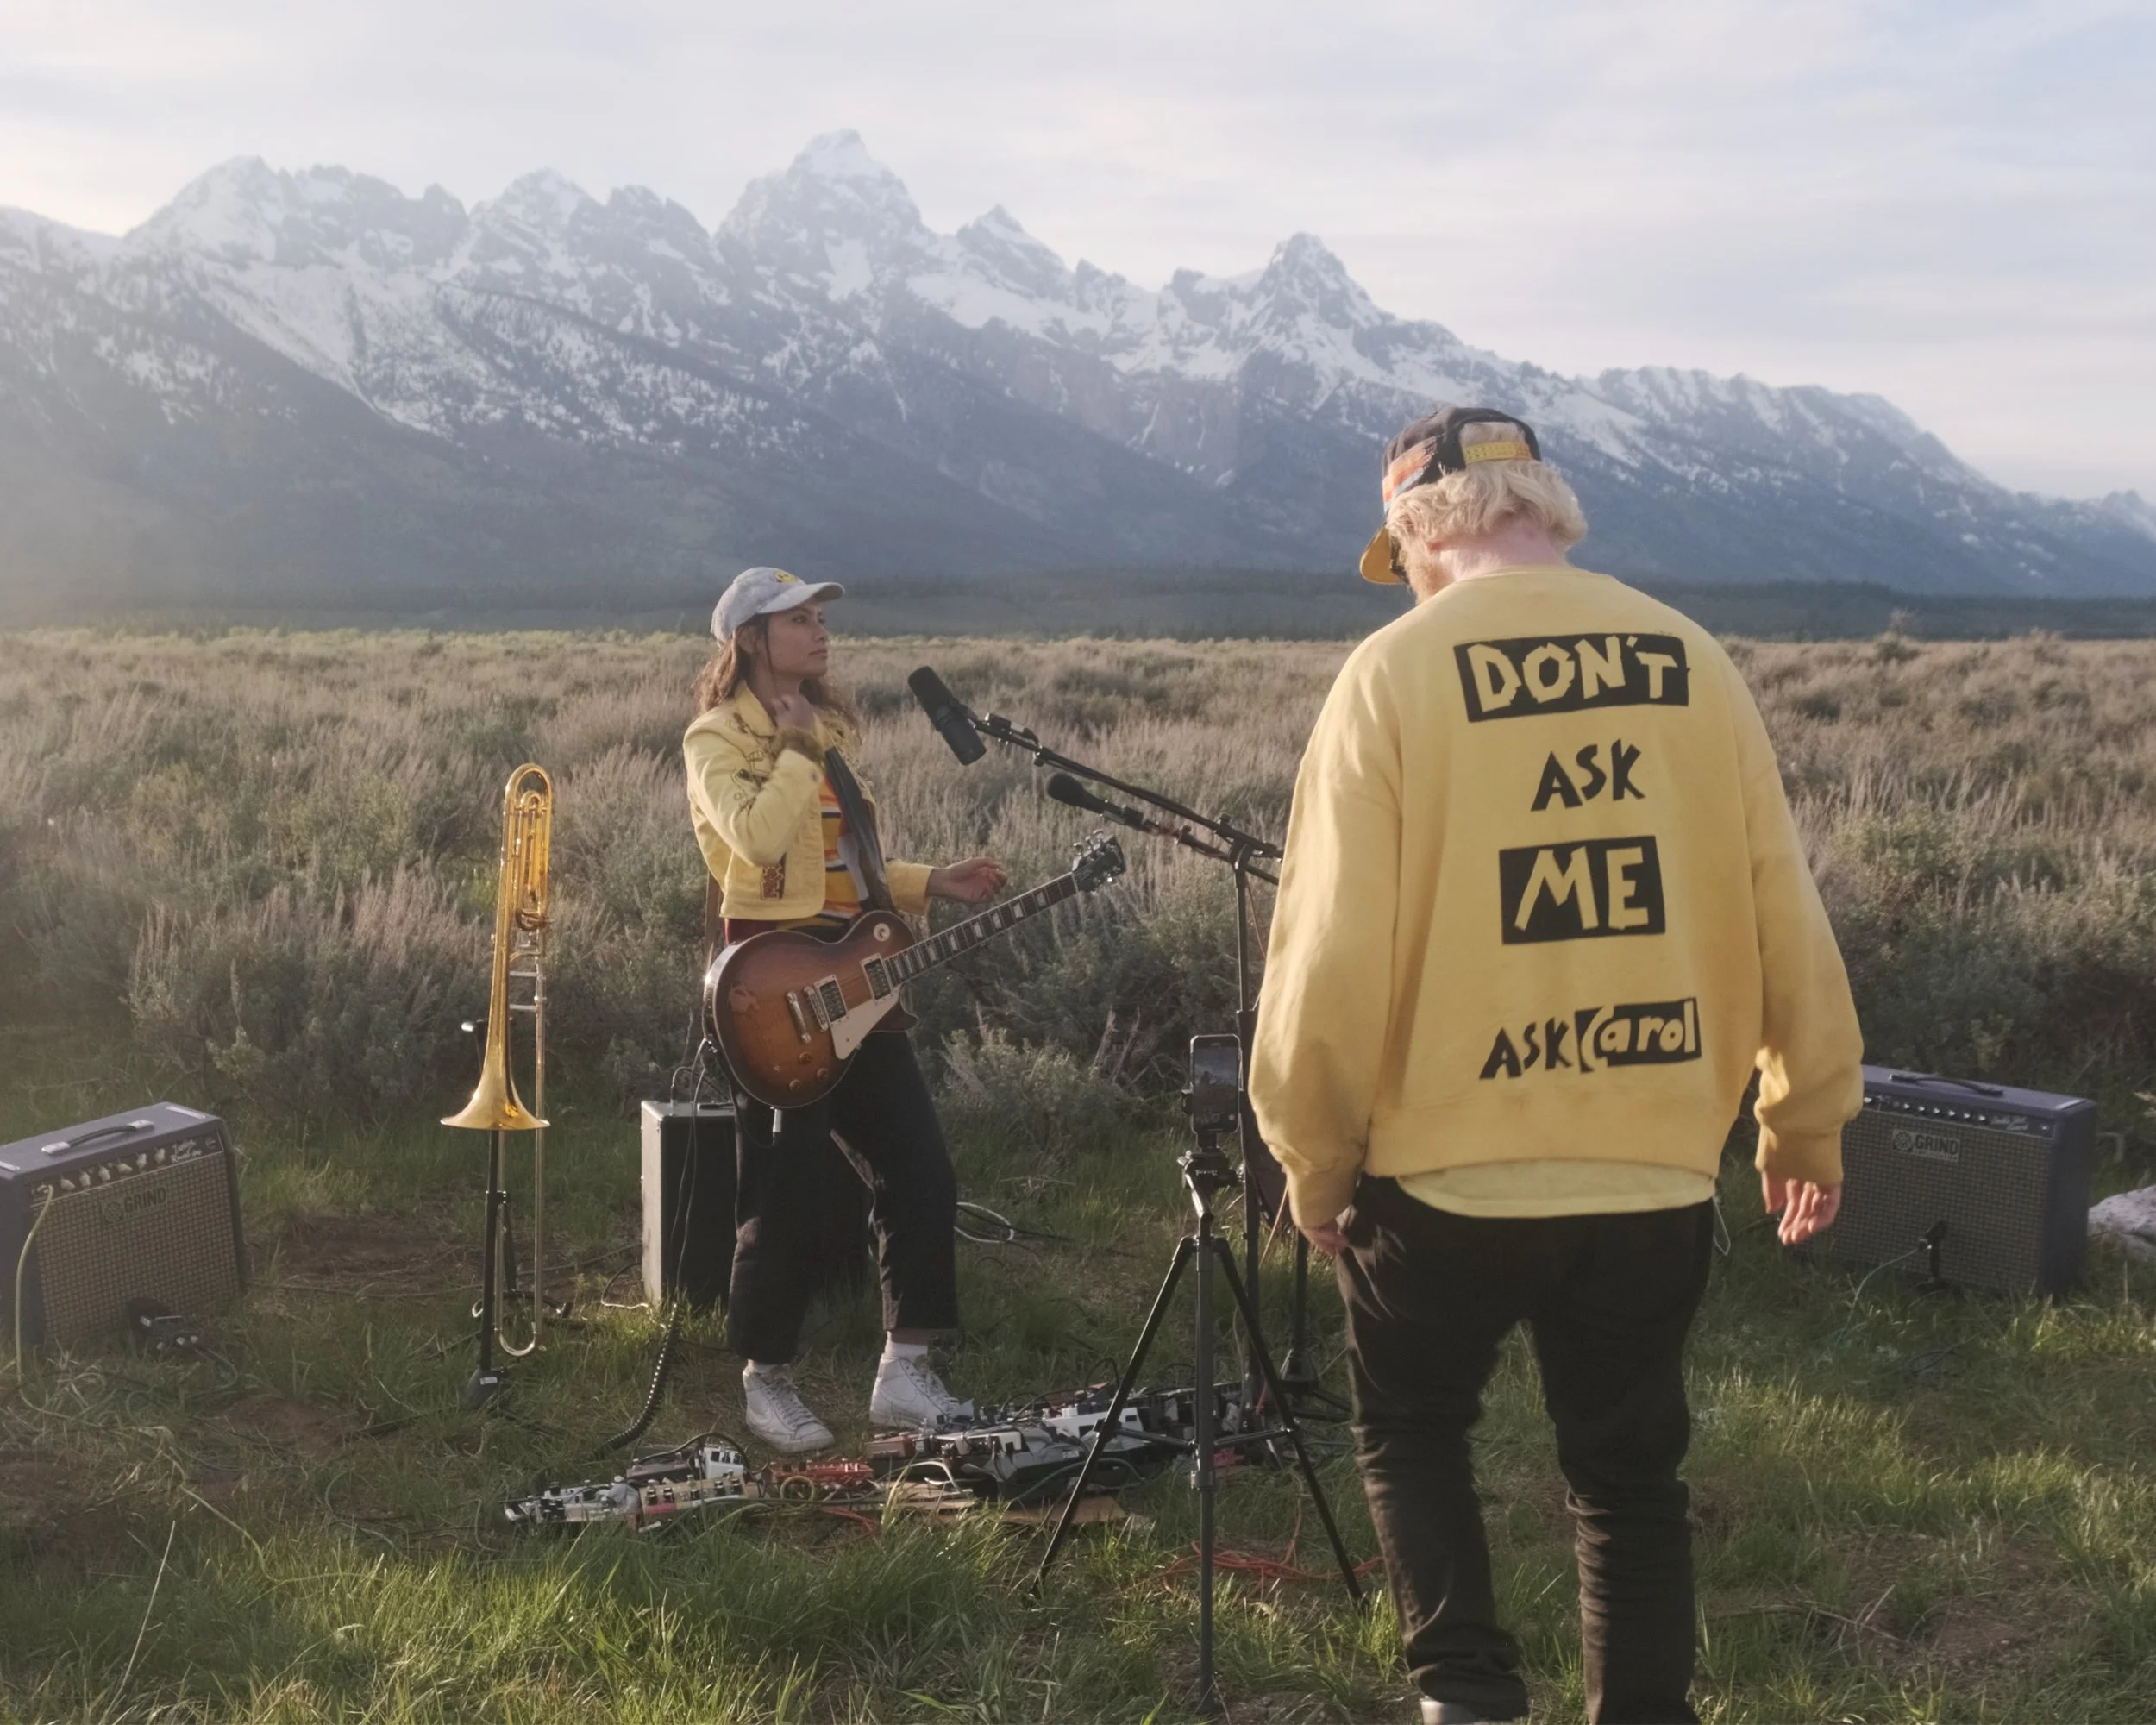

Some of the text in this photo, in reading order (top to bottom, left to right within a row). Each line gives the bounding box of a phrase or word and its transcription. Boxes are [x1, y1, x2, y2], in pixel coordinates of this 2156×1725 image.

[1467, 635, 1678, 713] DON'T
[1530, 738, 1646, 812] ASK
[1514, 845, 1650, 932] ME
[1915, 1133, 1959, 1155] GRIND
[123, 1186, 167, 1214] GRIND
